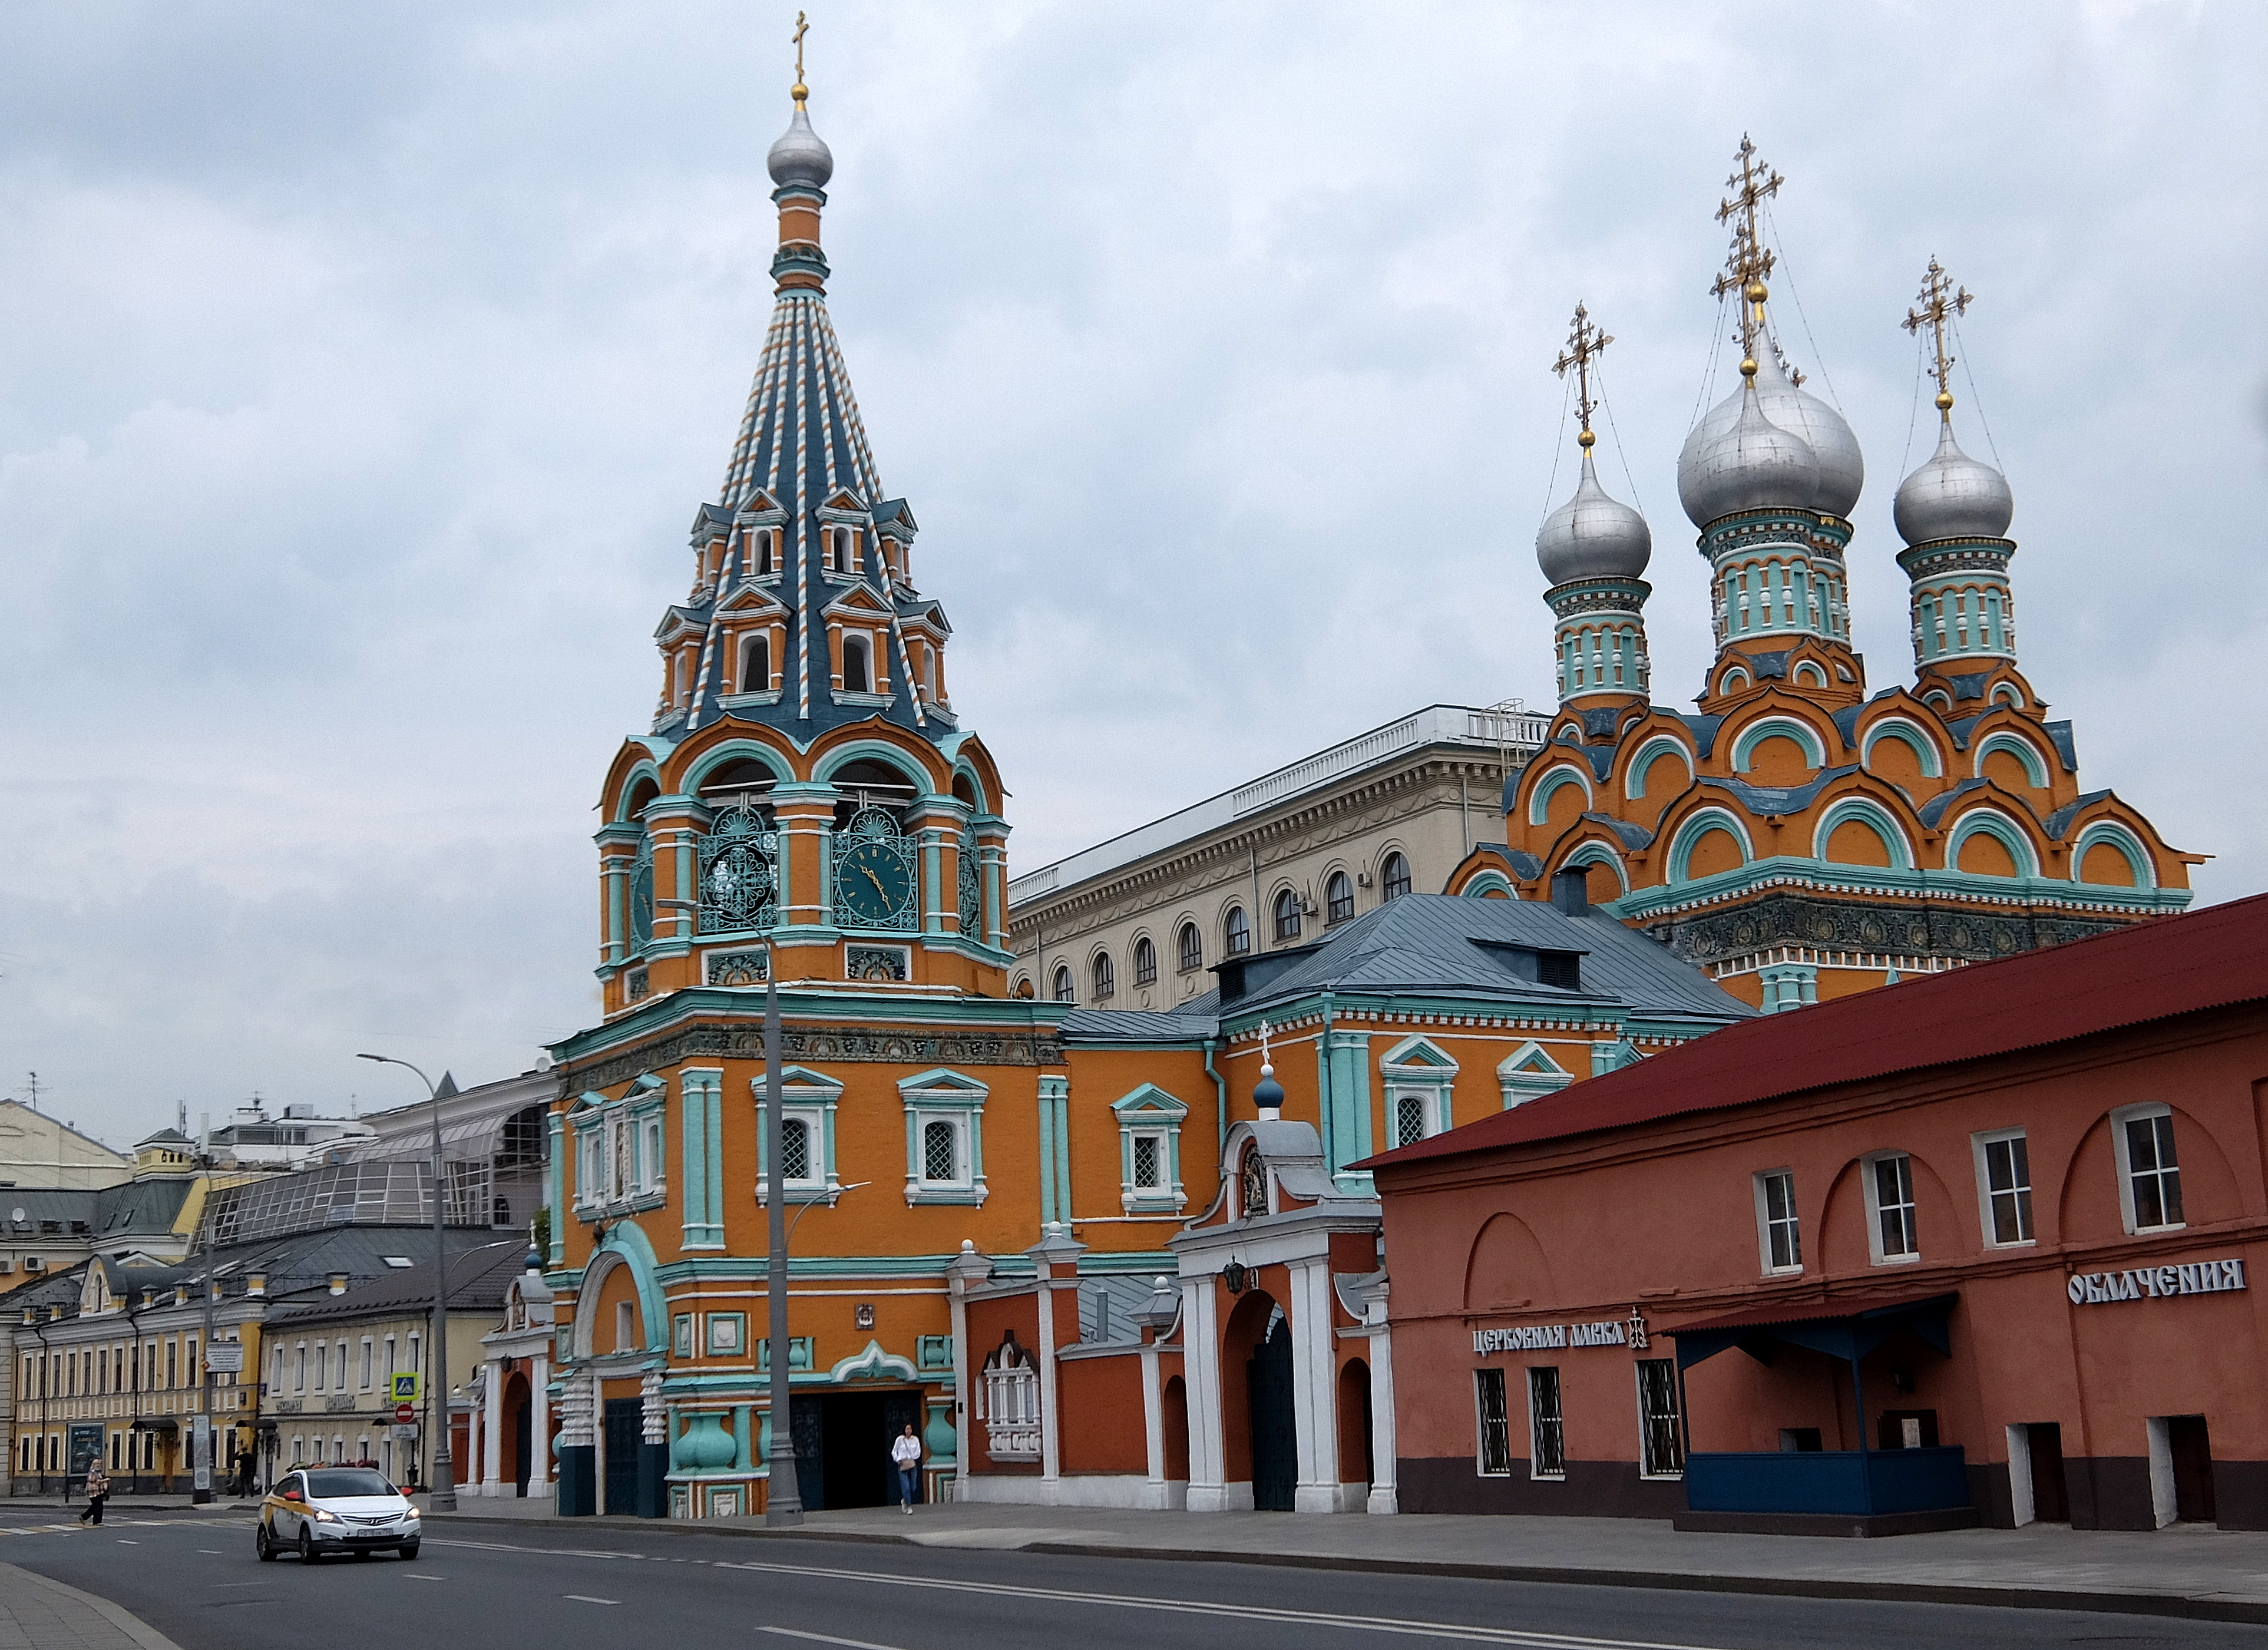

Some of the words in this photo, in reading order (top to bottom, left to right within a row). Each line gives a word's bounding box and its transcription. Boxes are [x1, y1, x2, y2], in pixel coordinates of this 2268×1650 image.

[2068, 1259, 2247, 1304] ОБЛАЧЕНИЯ
[1473, 1325, 1567, 1357] ЦЕРКОВНАЯ
[1570, 1321, 1626, 1347] ЛАВКА
